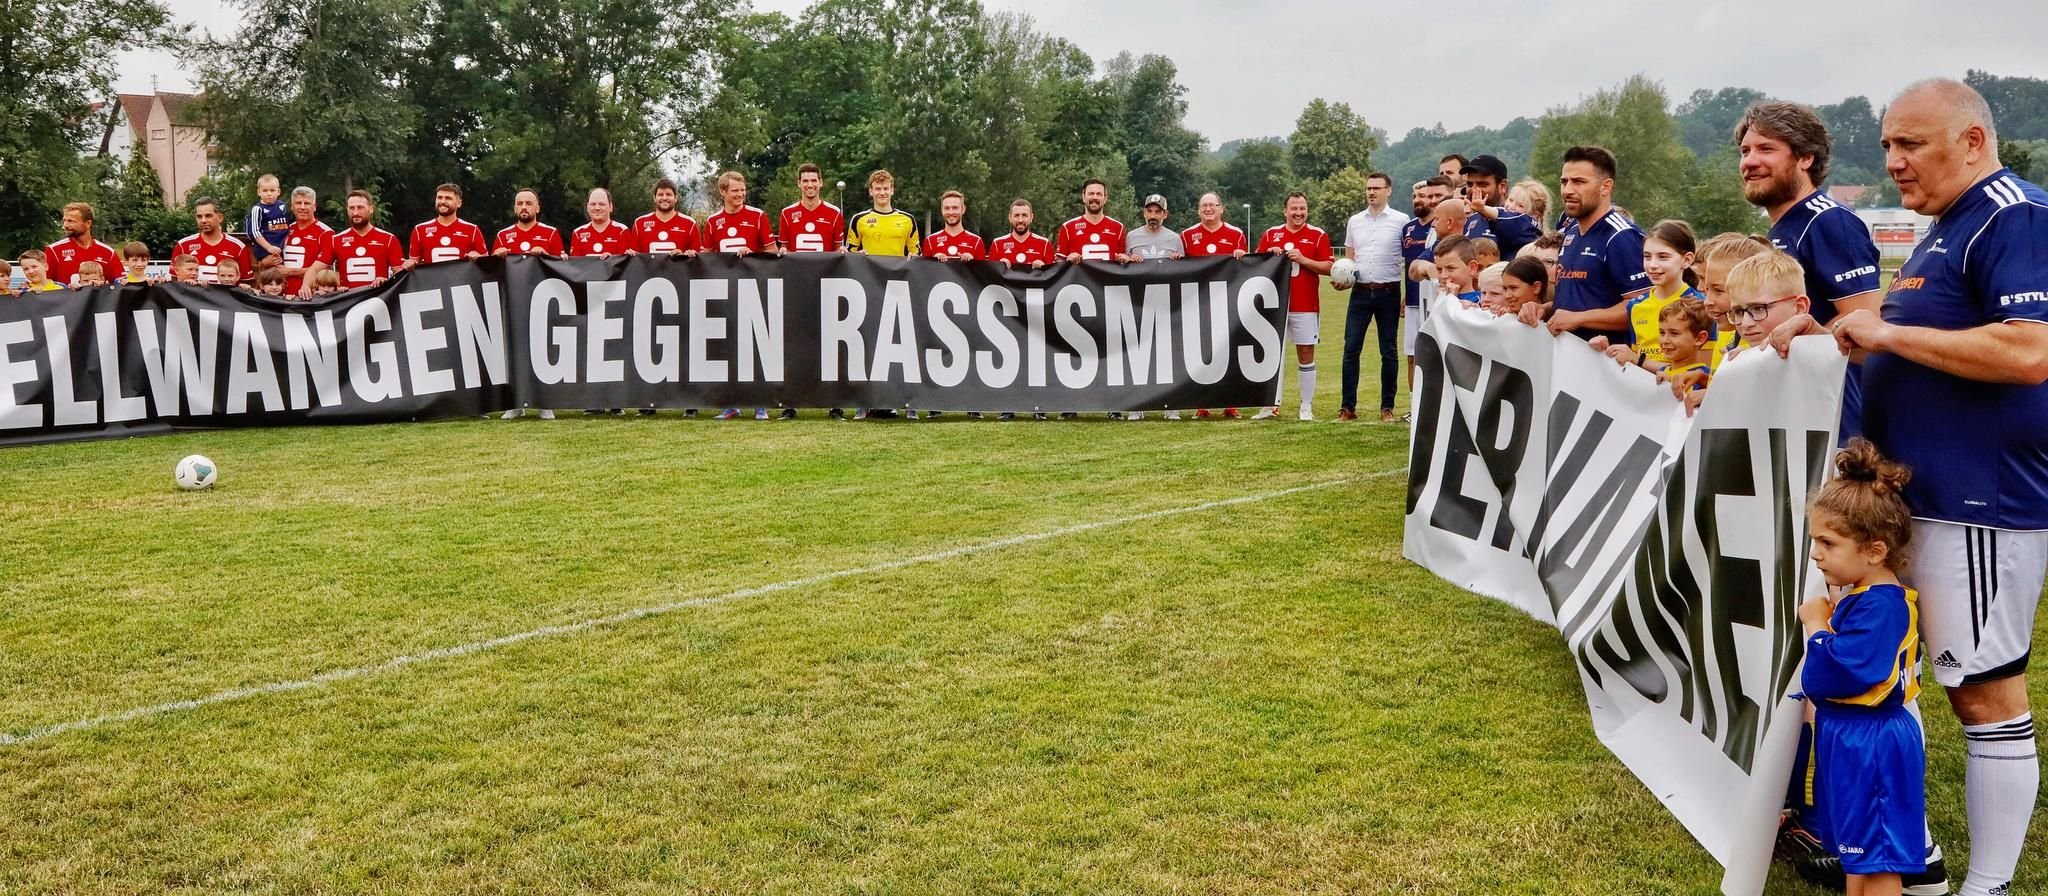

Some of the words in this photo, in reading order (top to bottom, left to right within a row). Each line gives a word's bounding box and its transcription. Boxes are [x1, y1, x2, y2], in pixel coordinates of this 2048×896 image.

[1834, 266, 1876, 283] B'STYLED
[2000, 291, 2048, 306] B'STYL
[0, 281, 510, 429] ELLWANGEN
[529, 276, 785, 385] GEGEN
[819, 275, 1281, 389] RASSISMUS
[1933, 659, 1962, 669] adidas
